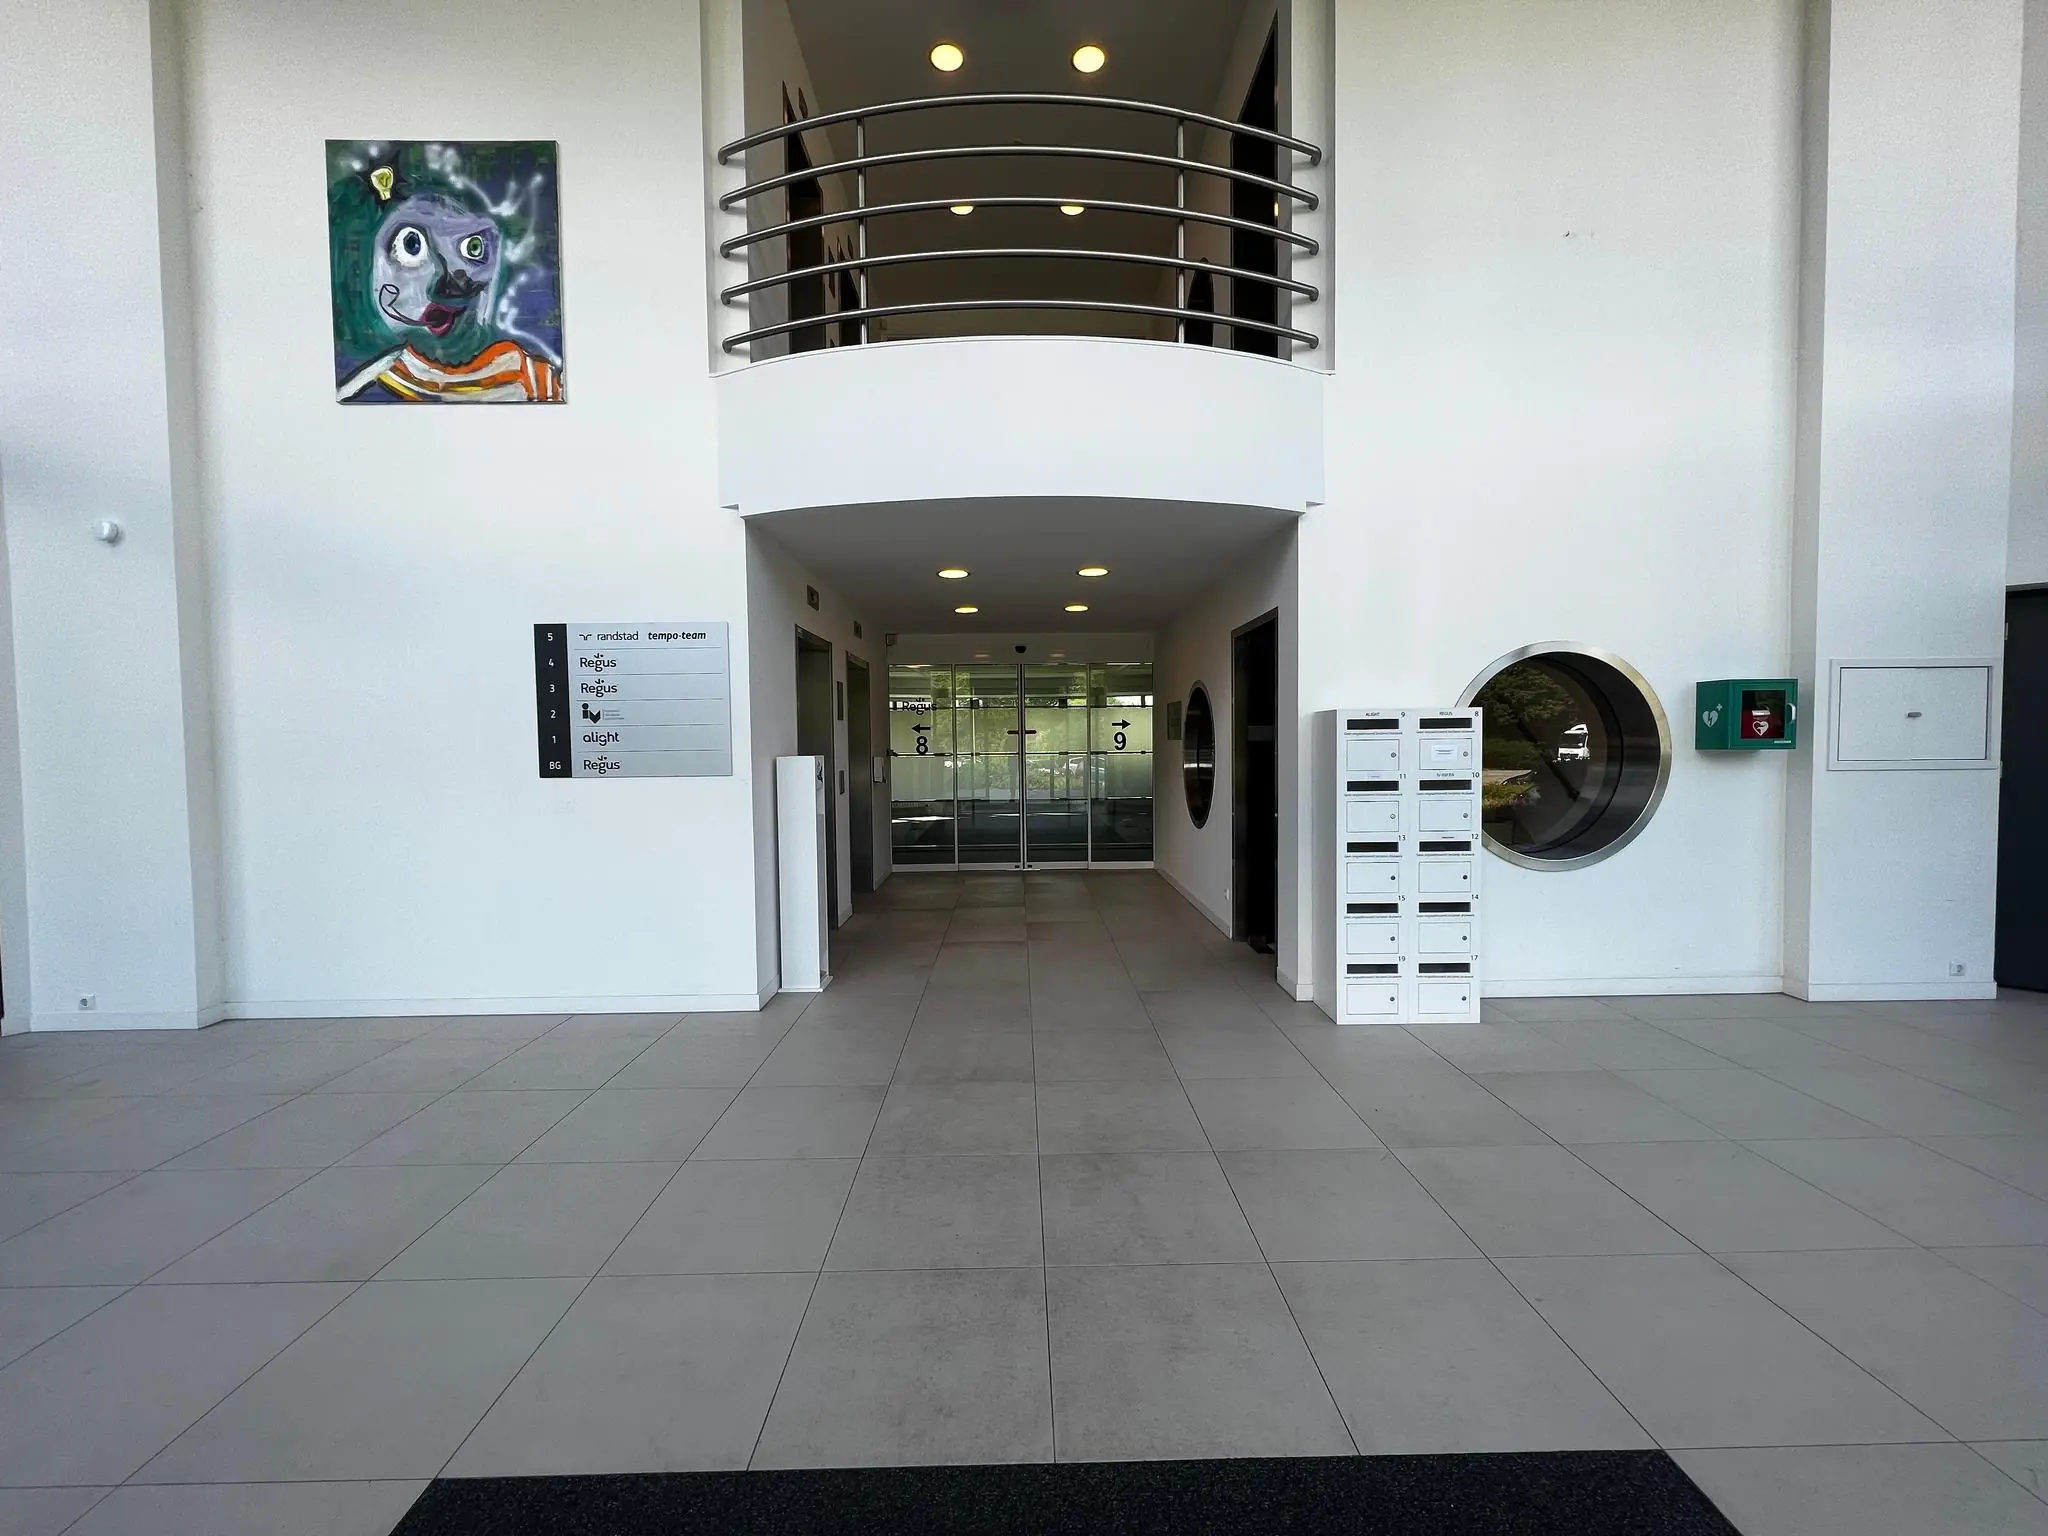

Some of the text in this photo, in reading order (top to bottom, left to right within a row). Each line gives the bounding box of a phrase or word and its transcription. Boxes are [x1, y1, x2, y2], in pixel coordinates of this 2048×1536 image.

[547, 632, 554, 641] 5
[597, 631, 639, 641] randstad
[579, 656, 617, 673] Regus
[549, 682, 618, 698] 3 Regus
[550, 710, 557, 719] 2
[903, 701, 937, 716] Regus
[551, 731, 620, 746] 1 alight
[916, 736, 929, 755] 8
[1113, 731, 1127, 751] 9
[549, 758, 621, 775] BG Regus
